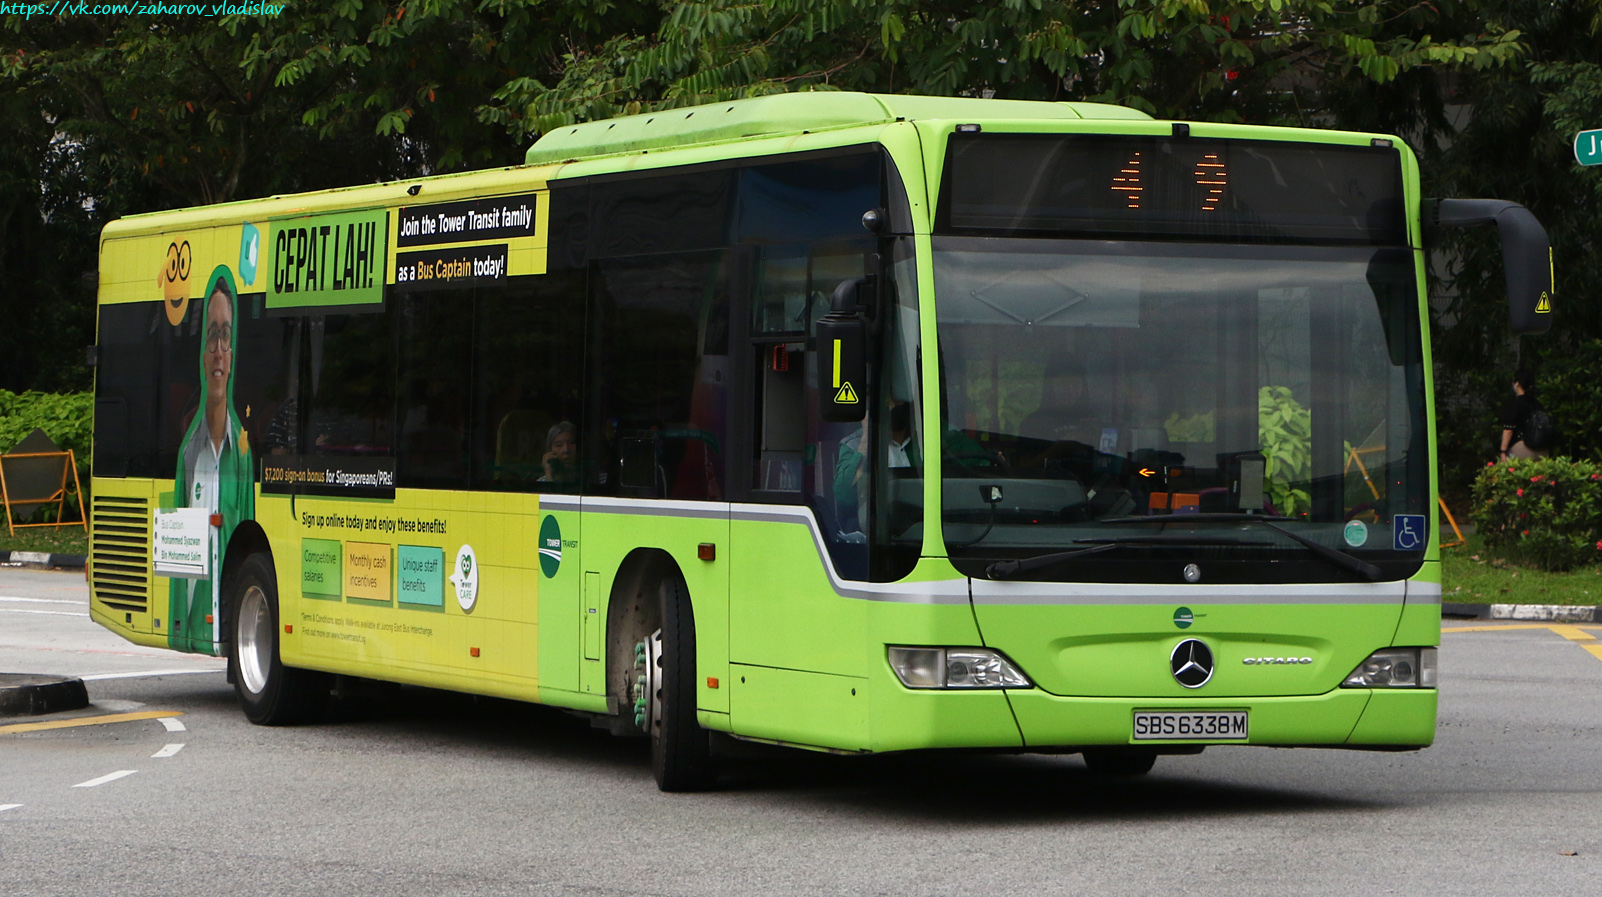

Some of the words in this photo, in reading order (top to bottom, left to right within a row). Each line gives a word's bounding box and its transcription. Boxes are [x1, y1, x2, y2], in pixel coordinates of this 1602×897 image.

[400, 215, 420, 237] Join
[421, 214, 436, 235] the
[438, 213, 466, 233] Tower
[468, 207, 500, 230] Transit
[501, 204, 532, 229] family
[274, 225, 331, 294] CEPAT
[333, 221, 376, 291] LAH!
[398, 265, 408, 282] as
[409, 265, 416, 281] a
[417, 260, 434, 280] Bus
[435, 256, 472, 282] Captain
[473, 254, 505, 279] today!
[264, 467, 284, 483] $7,200
[284, 468, 306, 483] sign-on
[307, 468, 325, 482] bonus
[325, 469, 335, 483] for
[335, 469, 393, 487] Singaporeans/PRs!
[302, 512, 315, 528] Sign
[316, 515, 325, 529] up
[325, 513, 344, 528] online
[345, 515, 364, 531] today
[365, 516, 377, 530] and
[378, 516, 396, 534] enjoy
[397, 517, 416, 532] these
[417, 518, 447, 534] benefits!
[546, 538, 561, 548] TOWER
[562, 540, 578, 548] TRANSIT
[304, 549, 337, 565] Competitive
[349, 553, 372, 570] Monthly
[373, 556, 387, 569] cash
[402, 557, 423, 574] Unique
[424, 559, 438, 573] staff
[304, 569, 324, 583] salaries
[349, 572, 377, 588] incentives
[402, 577, 426, 592] benefits
[1242, 656, 1312, 665] CITARO
